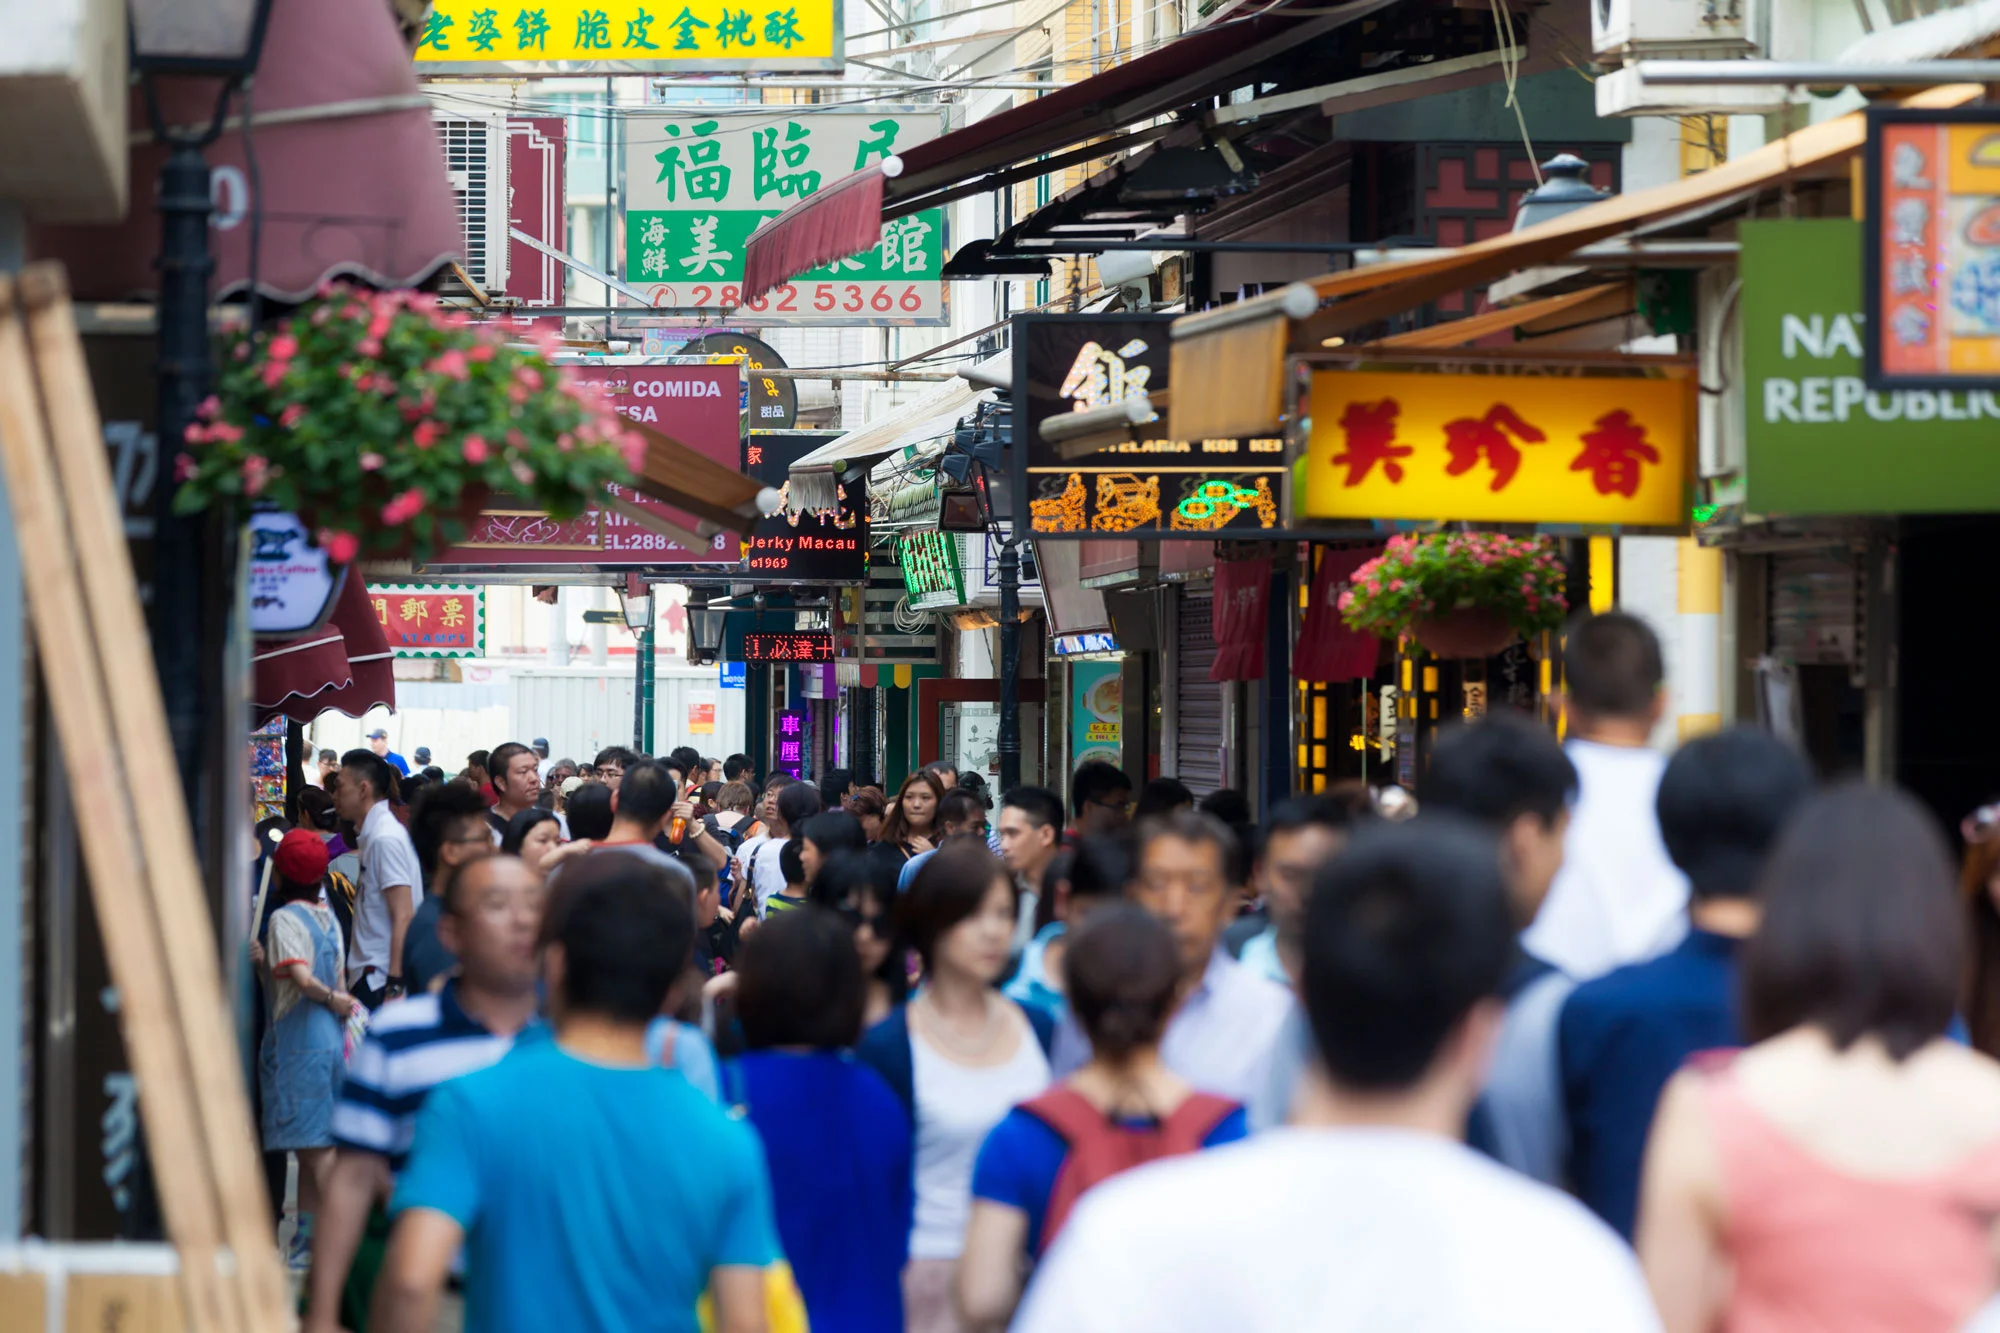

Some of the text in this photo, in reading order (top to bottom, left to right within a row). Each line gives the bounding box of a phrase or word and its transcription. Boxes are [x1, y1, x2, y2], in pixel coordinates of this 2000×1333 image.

[640, 216, 670, 279] 海鮮
[813, 284, 922, 312] 5366
[633, 380, 722, 398] COMIDA
[760, 405, 785, 418] 甜品
[749, 535, 856, 552] Jerky Macau
[401, 633, 466, 643] STAMPS
